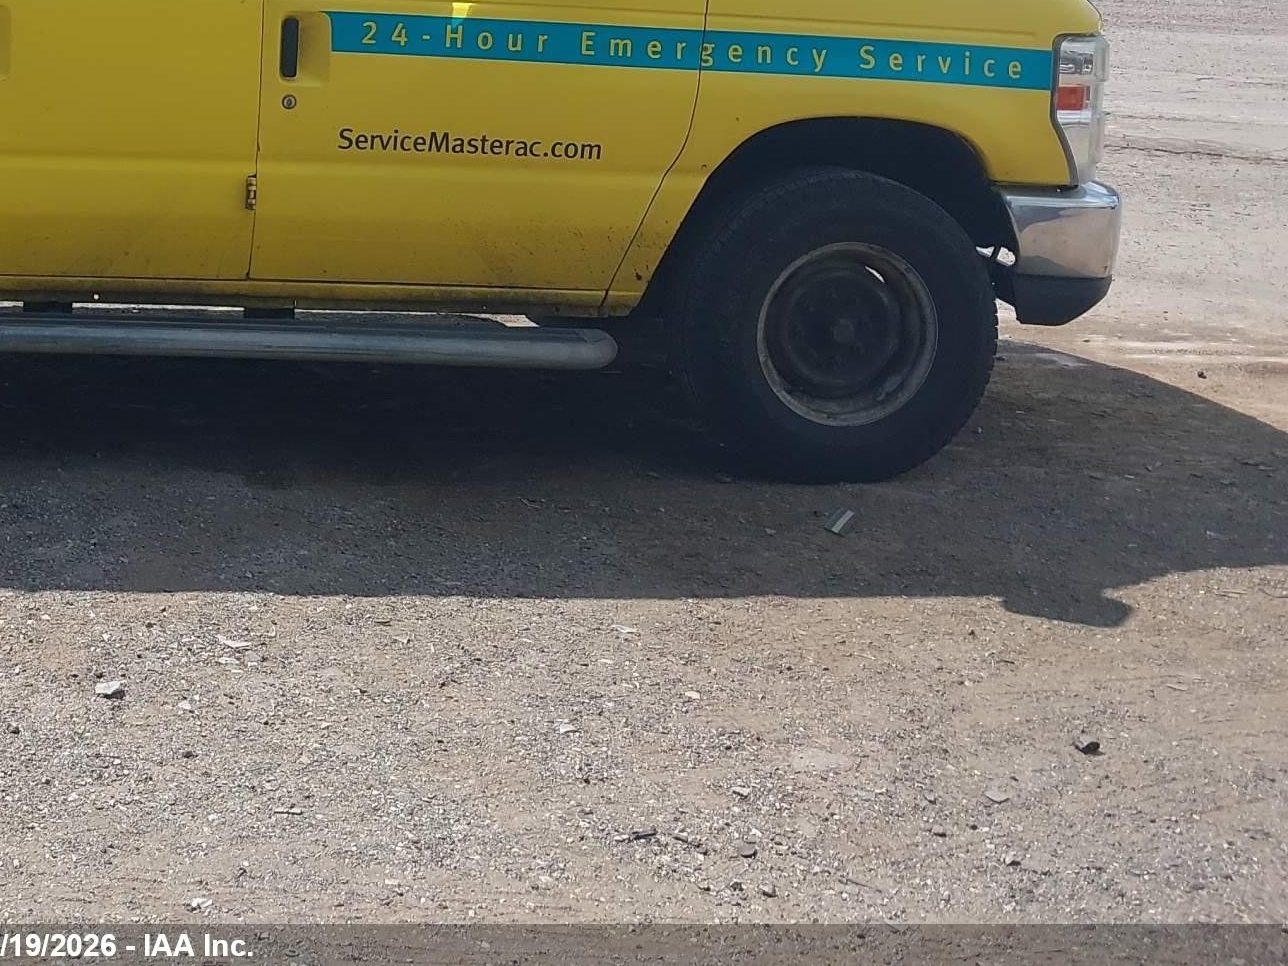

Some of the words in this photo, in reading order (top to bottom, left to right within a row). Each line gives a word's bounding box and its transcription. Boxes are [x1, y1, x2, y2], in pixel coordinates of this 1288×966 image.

[361, 20, 548, 54] 24-Hour
[581, 30, 829, 73] Emergency
[858, 45, 1025, 80] Service
[337, 128, 603, 161] ServiceMasterac.com
